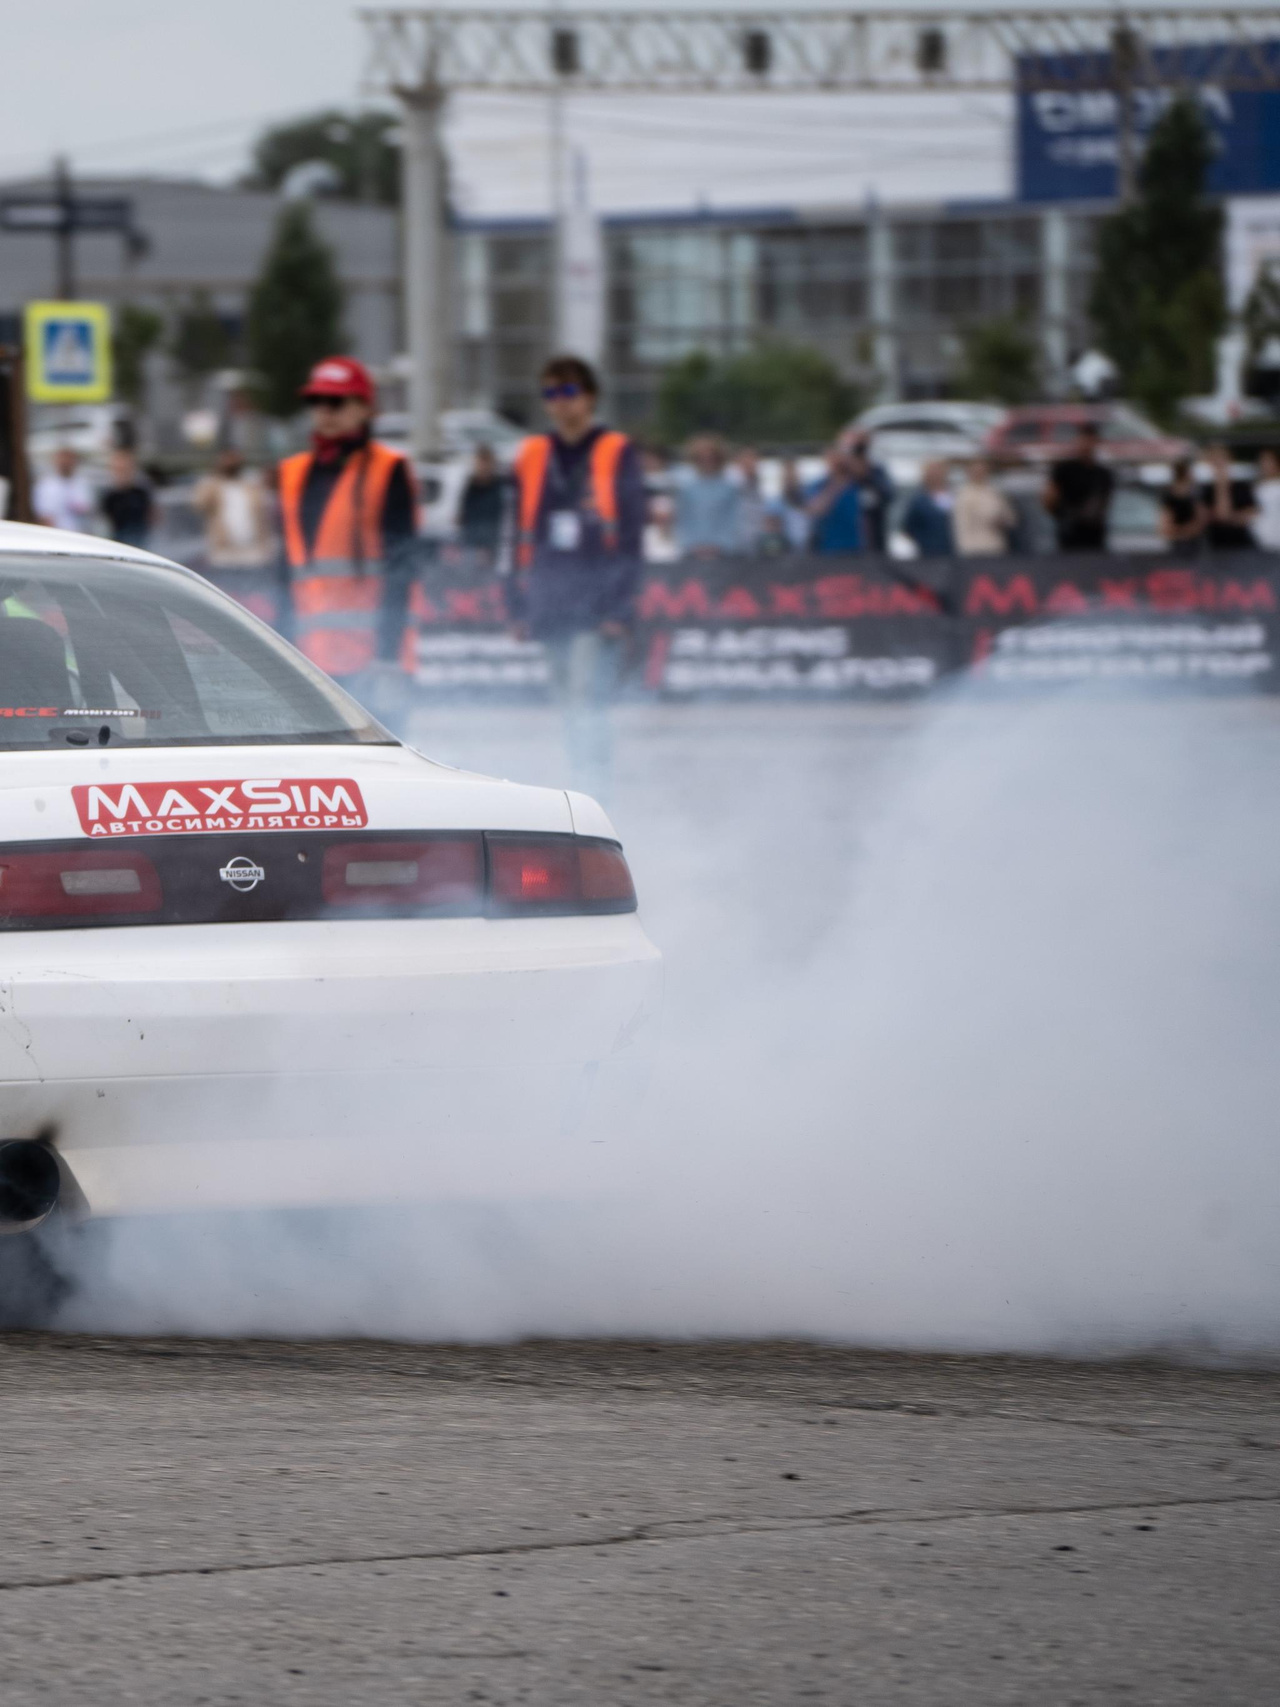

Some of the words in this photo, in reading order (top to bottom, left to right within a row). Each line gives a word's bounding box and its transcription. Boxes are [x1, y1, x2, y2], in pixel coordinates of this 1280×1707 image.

[665, 656, 934, 690] SIMULATOR
[62, 708, 135, 717] MONITOR
[90, 814, 363, 836] АВТОСИМУЛЯТОРЫ
[225, 870, 261, 878] NISSAN
